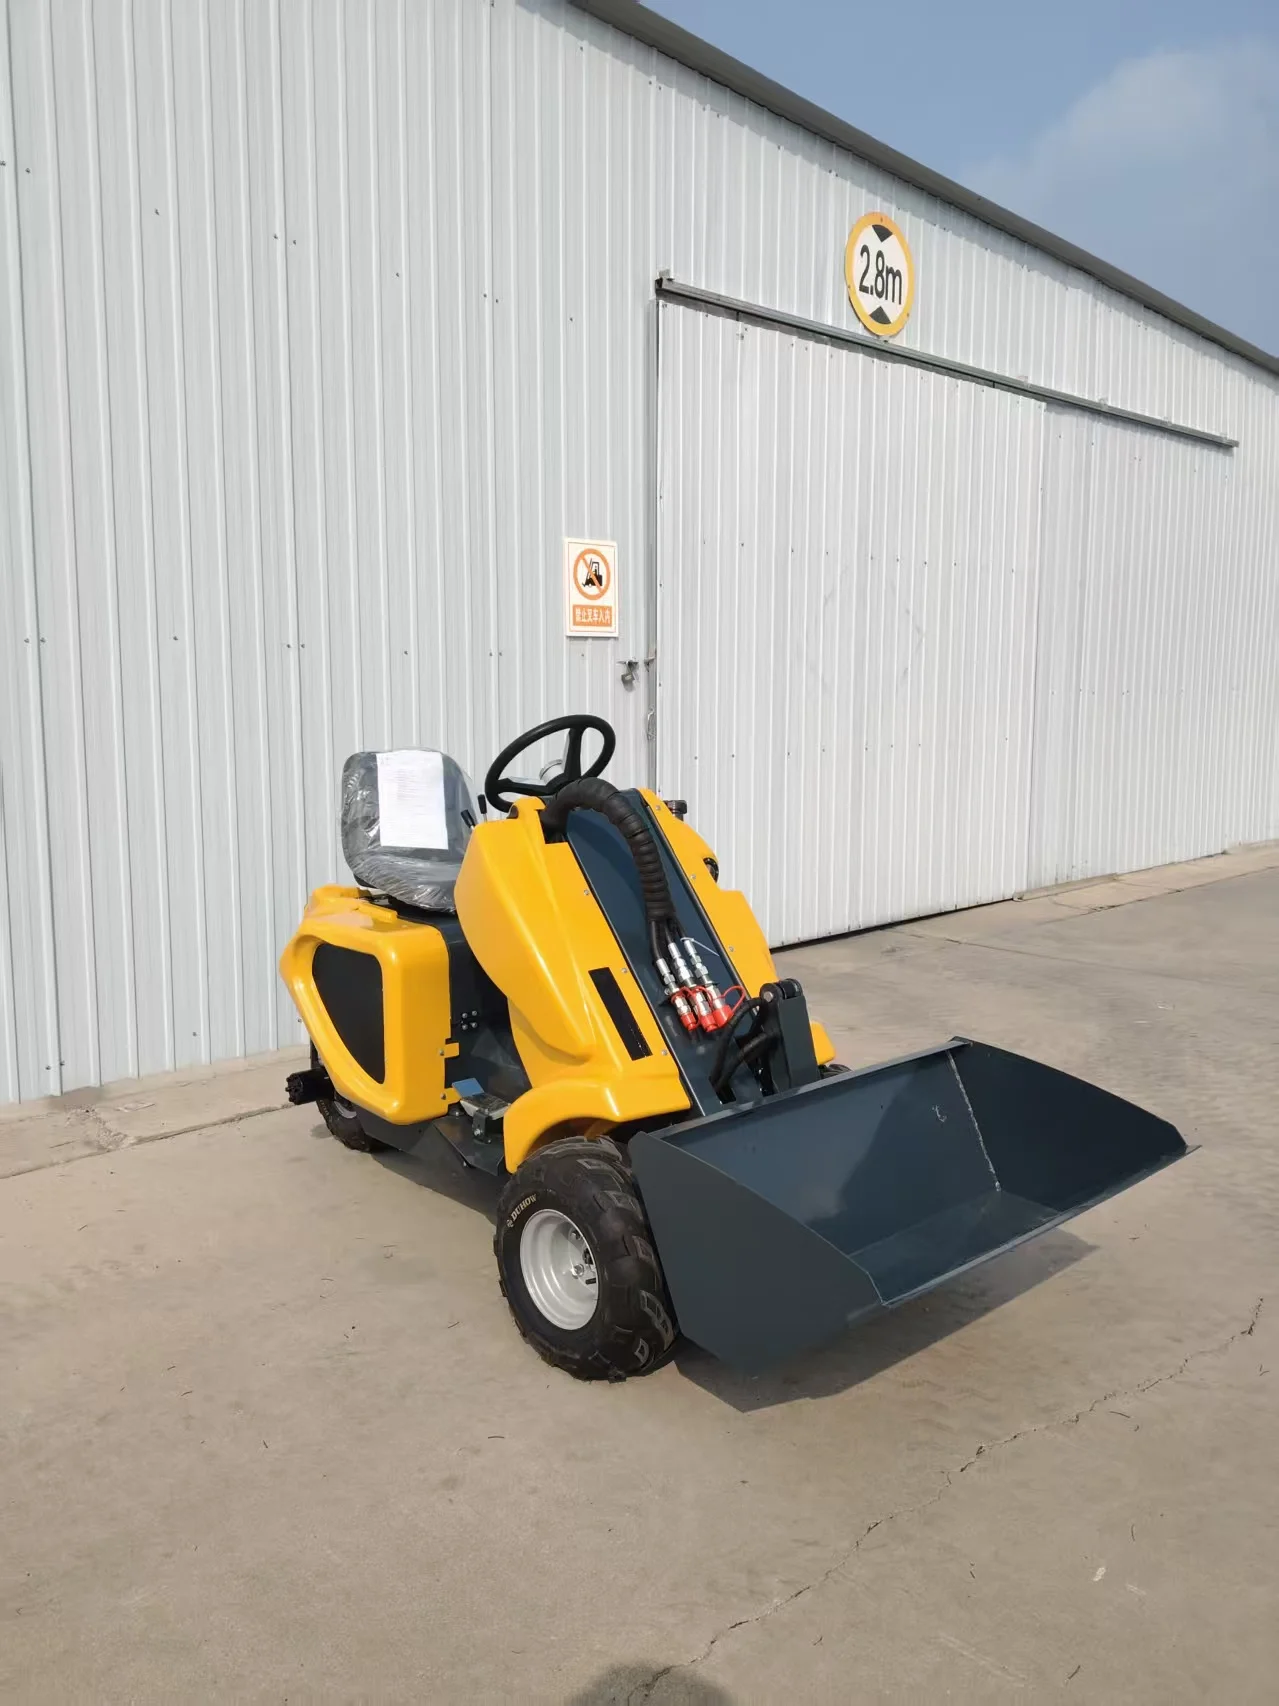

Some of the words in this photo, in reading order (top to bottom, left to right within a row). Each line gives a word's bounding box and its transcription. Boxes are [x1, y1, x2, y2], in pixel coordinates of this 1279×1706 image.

[859, 244, 902, 305] 2.8m
[575, 607, 611, 624] 禁止叉车入内
[511, 1194, 537, 1221] DUHOW
